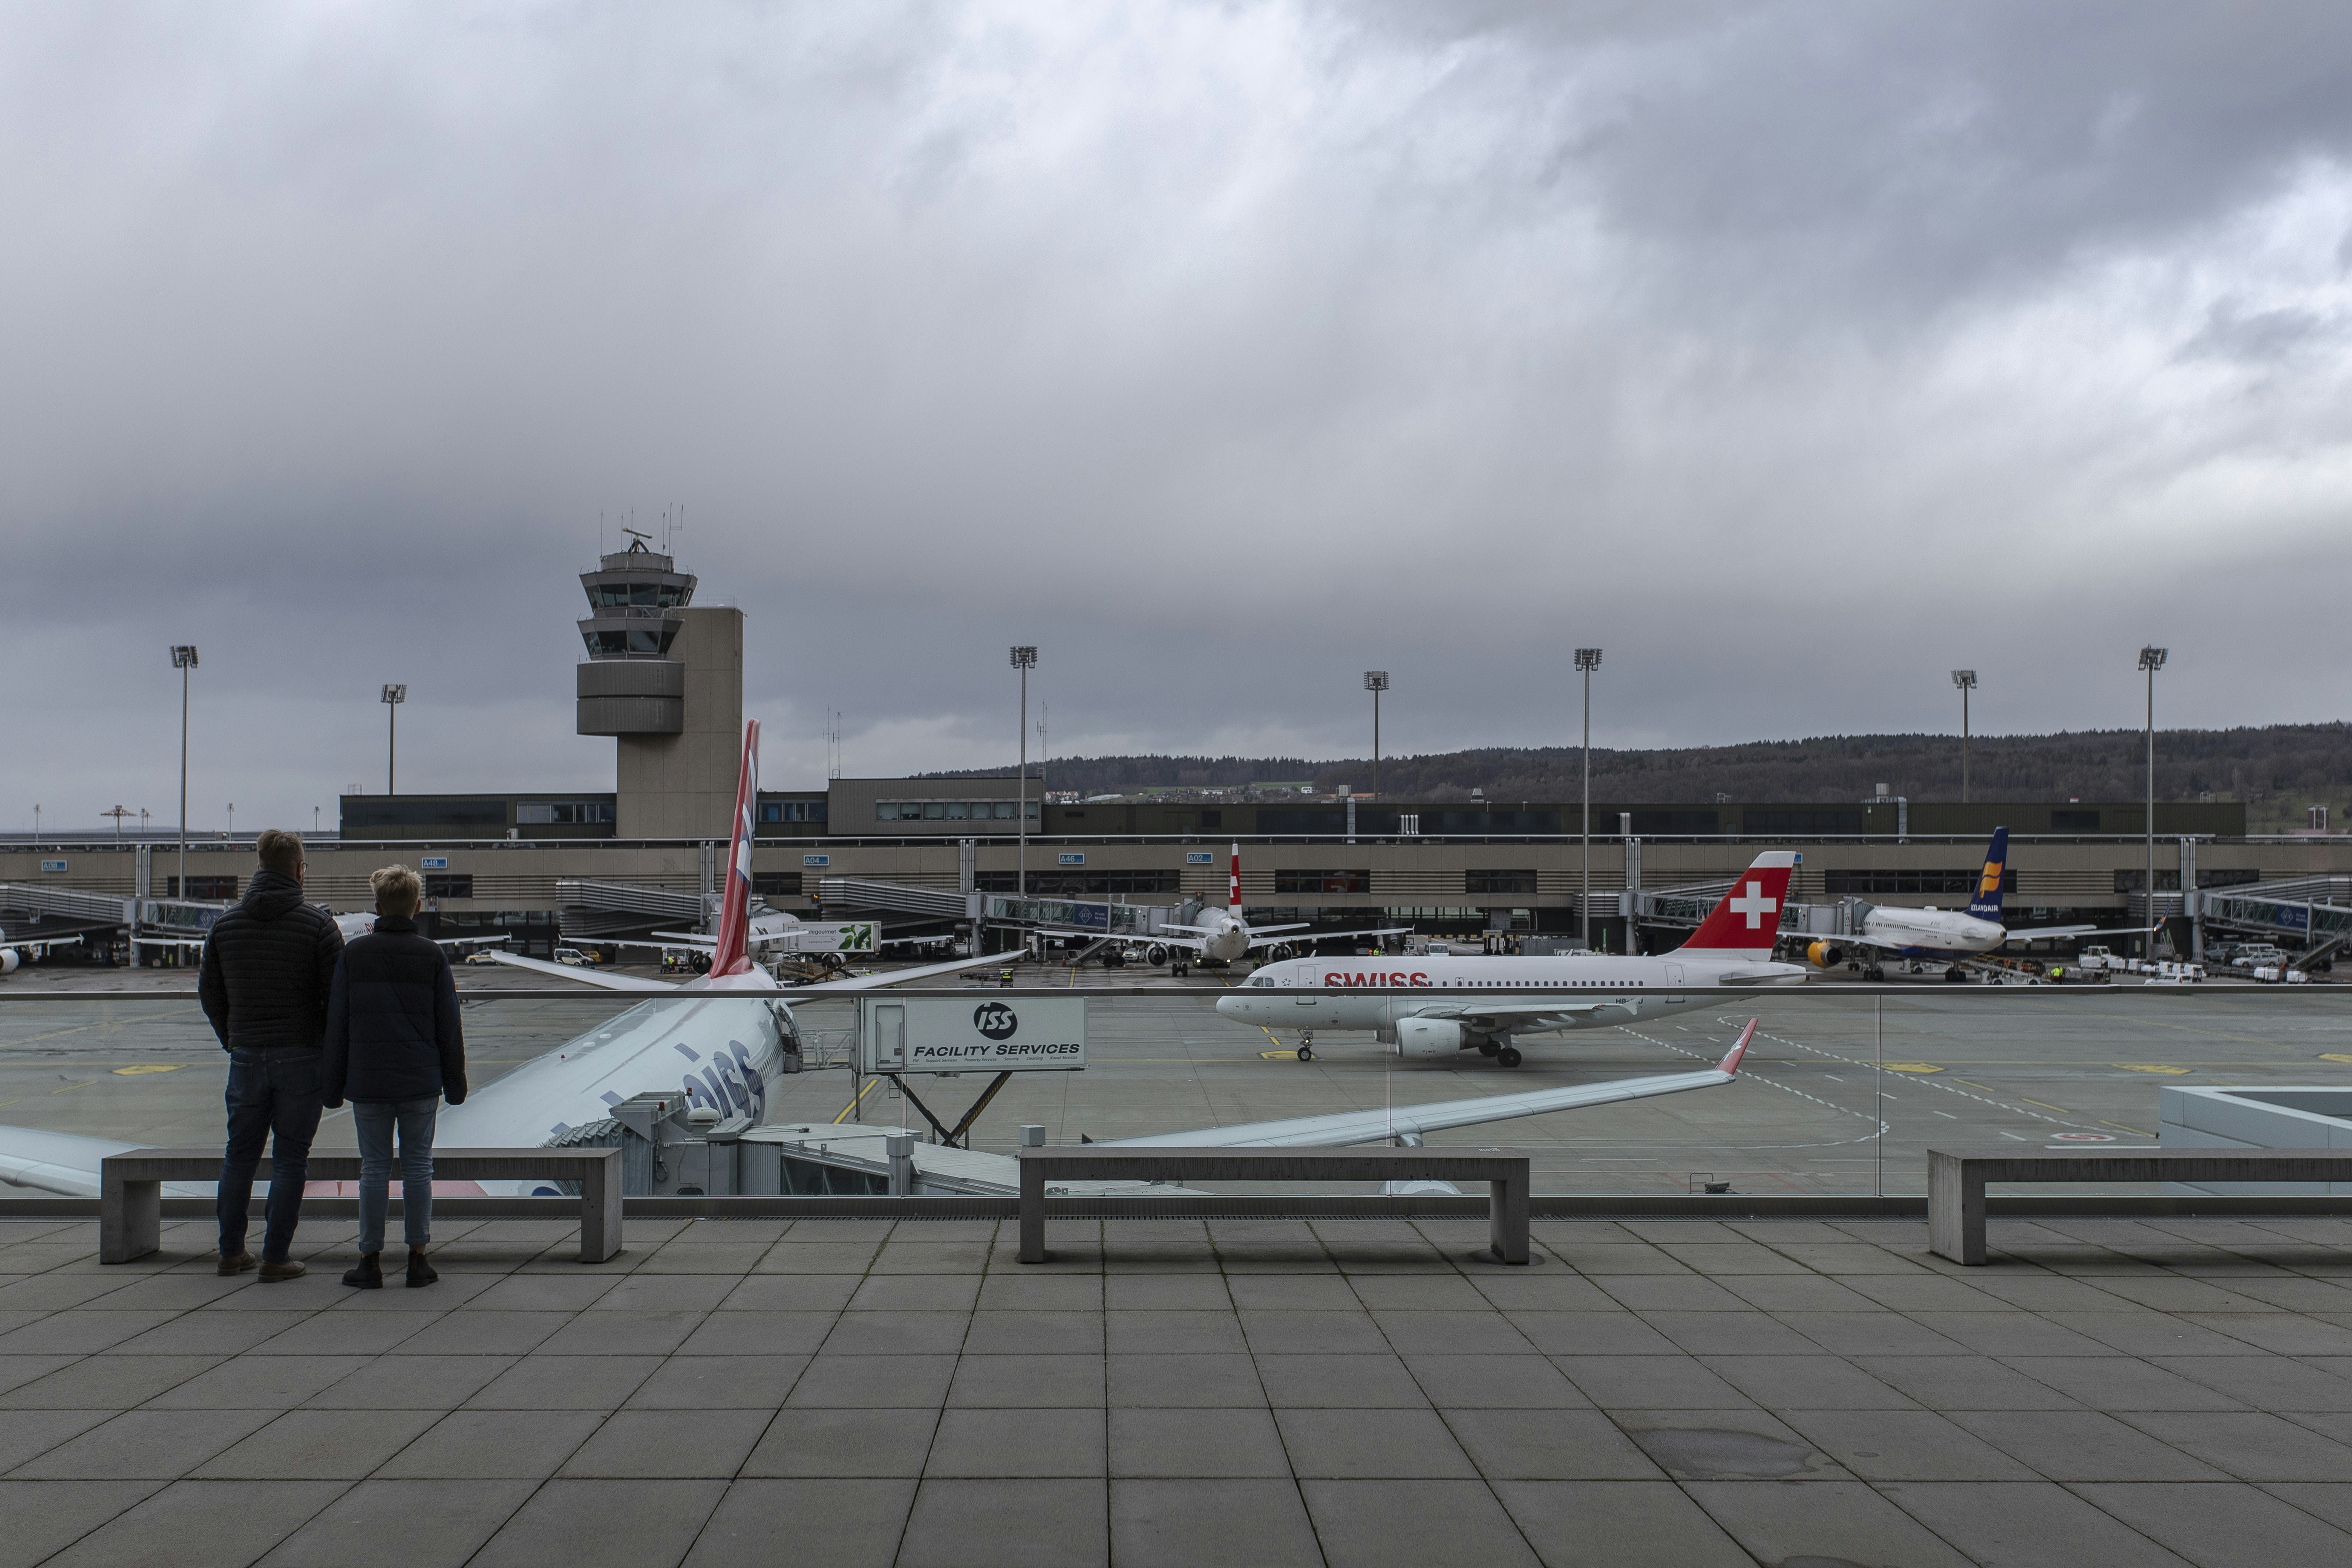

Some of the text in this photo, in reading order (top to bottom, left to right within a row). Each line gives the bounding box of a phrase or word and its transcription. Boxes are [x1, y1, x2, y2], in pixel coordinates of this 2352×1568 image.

[1971, 903, 1998, 912] ICELANDAIR
[1325, 972, 1429, 988] SWISS
[914, 1044, 1080, 1057] FACILITY SERVICES
